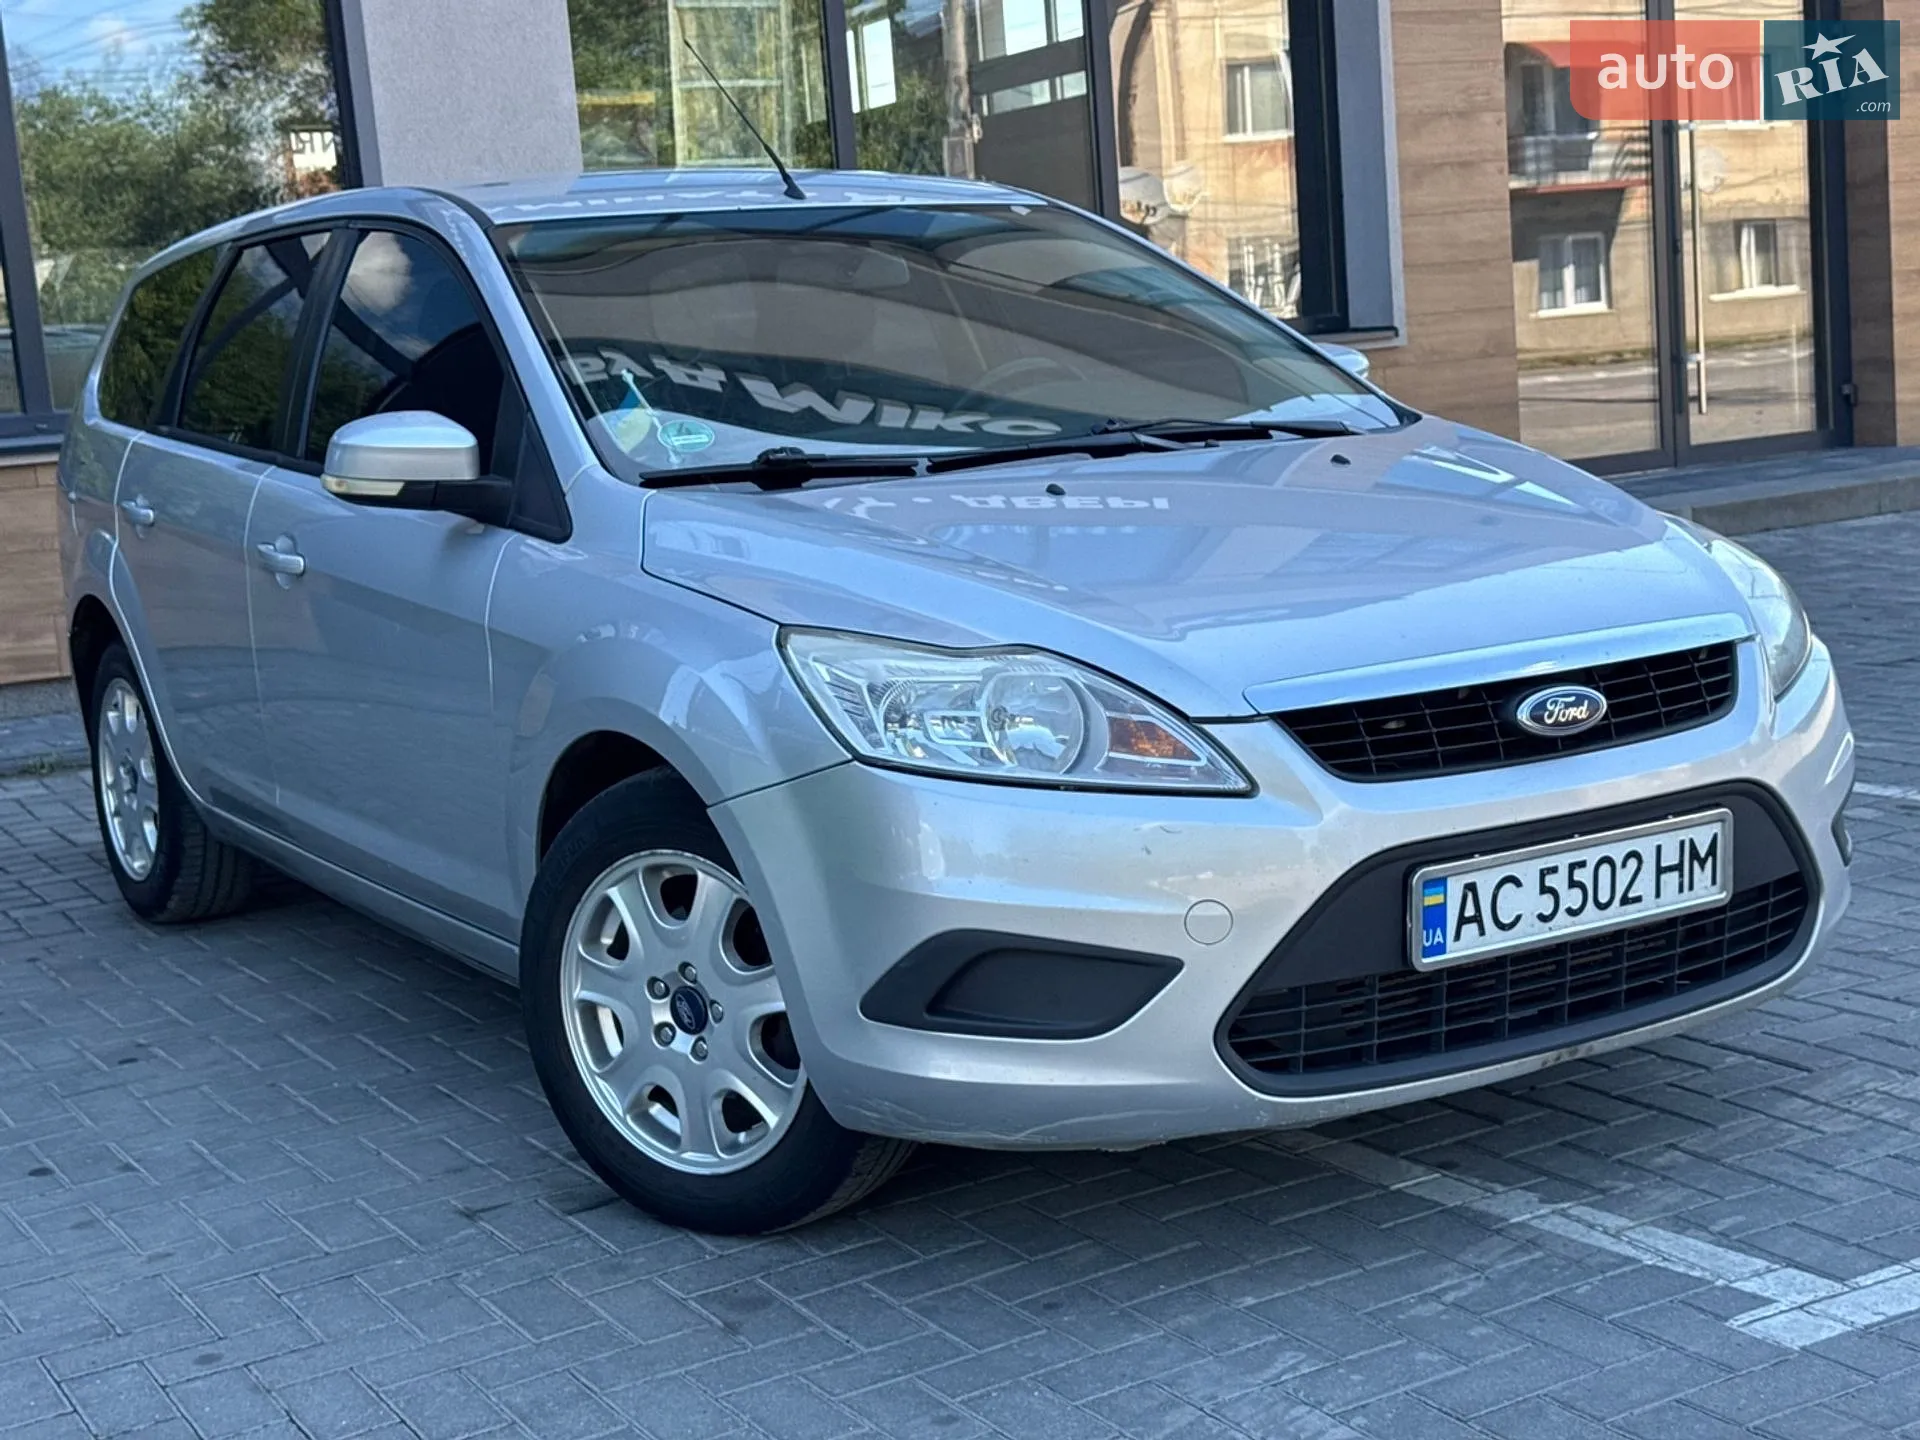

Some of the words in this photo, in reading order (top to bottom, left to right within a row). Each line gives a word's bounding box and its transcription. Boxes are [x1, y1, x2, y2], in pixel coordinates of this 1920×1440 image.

[1543, 695, 1590, 725] Ford
[1453, 874, 1524, 942] AC
[1536, 849, 1644, 924] 5502
[1655, 831, 1719, 900] HM
[1422, 927, 1445, 947] UA
